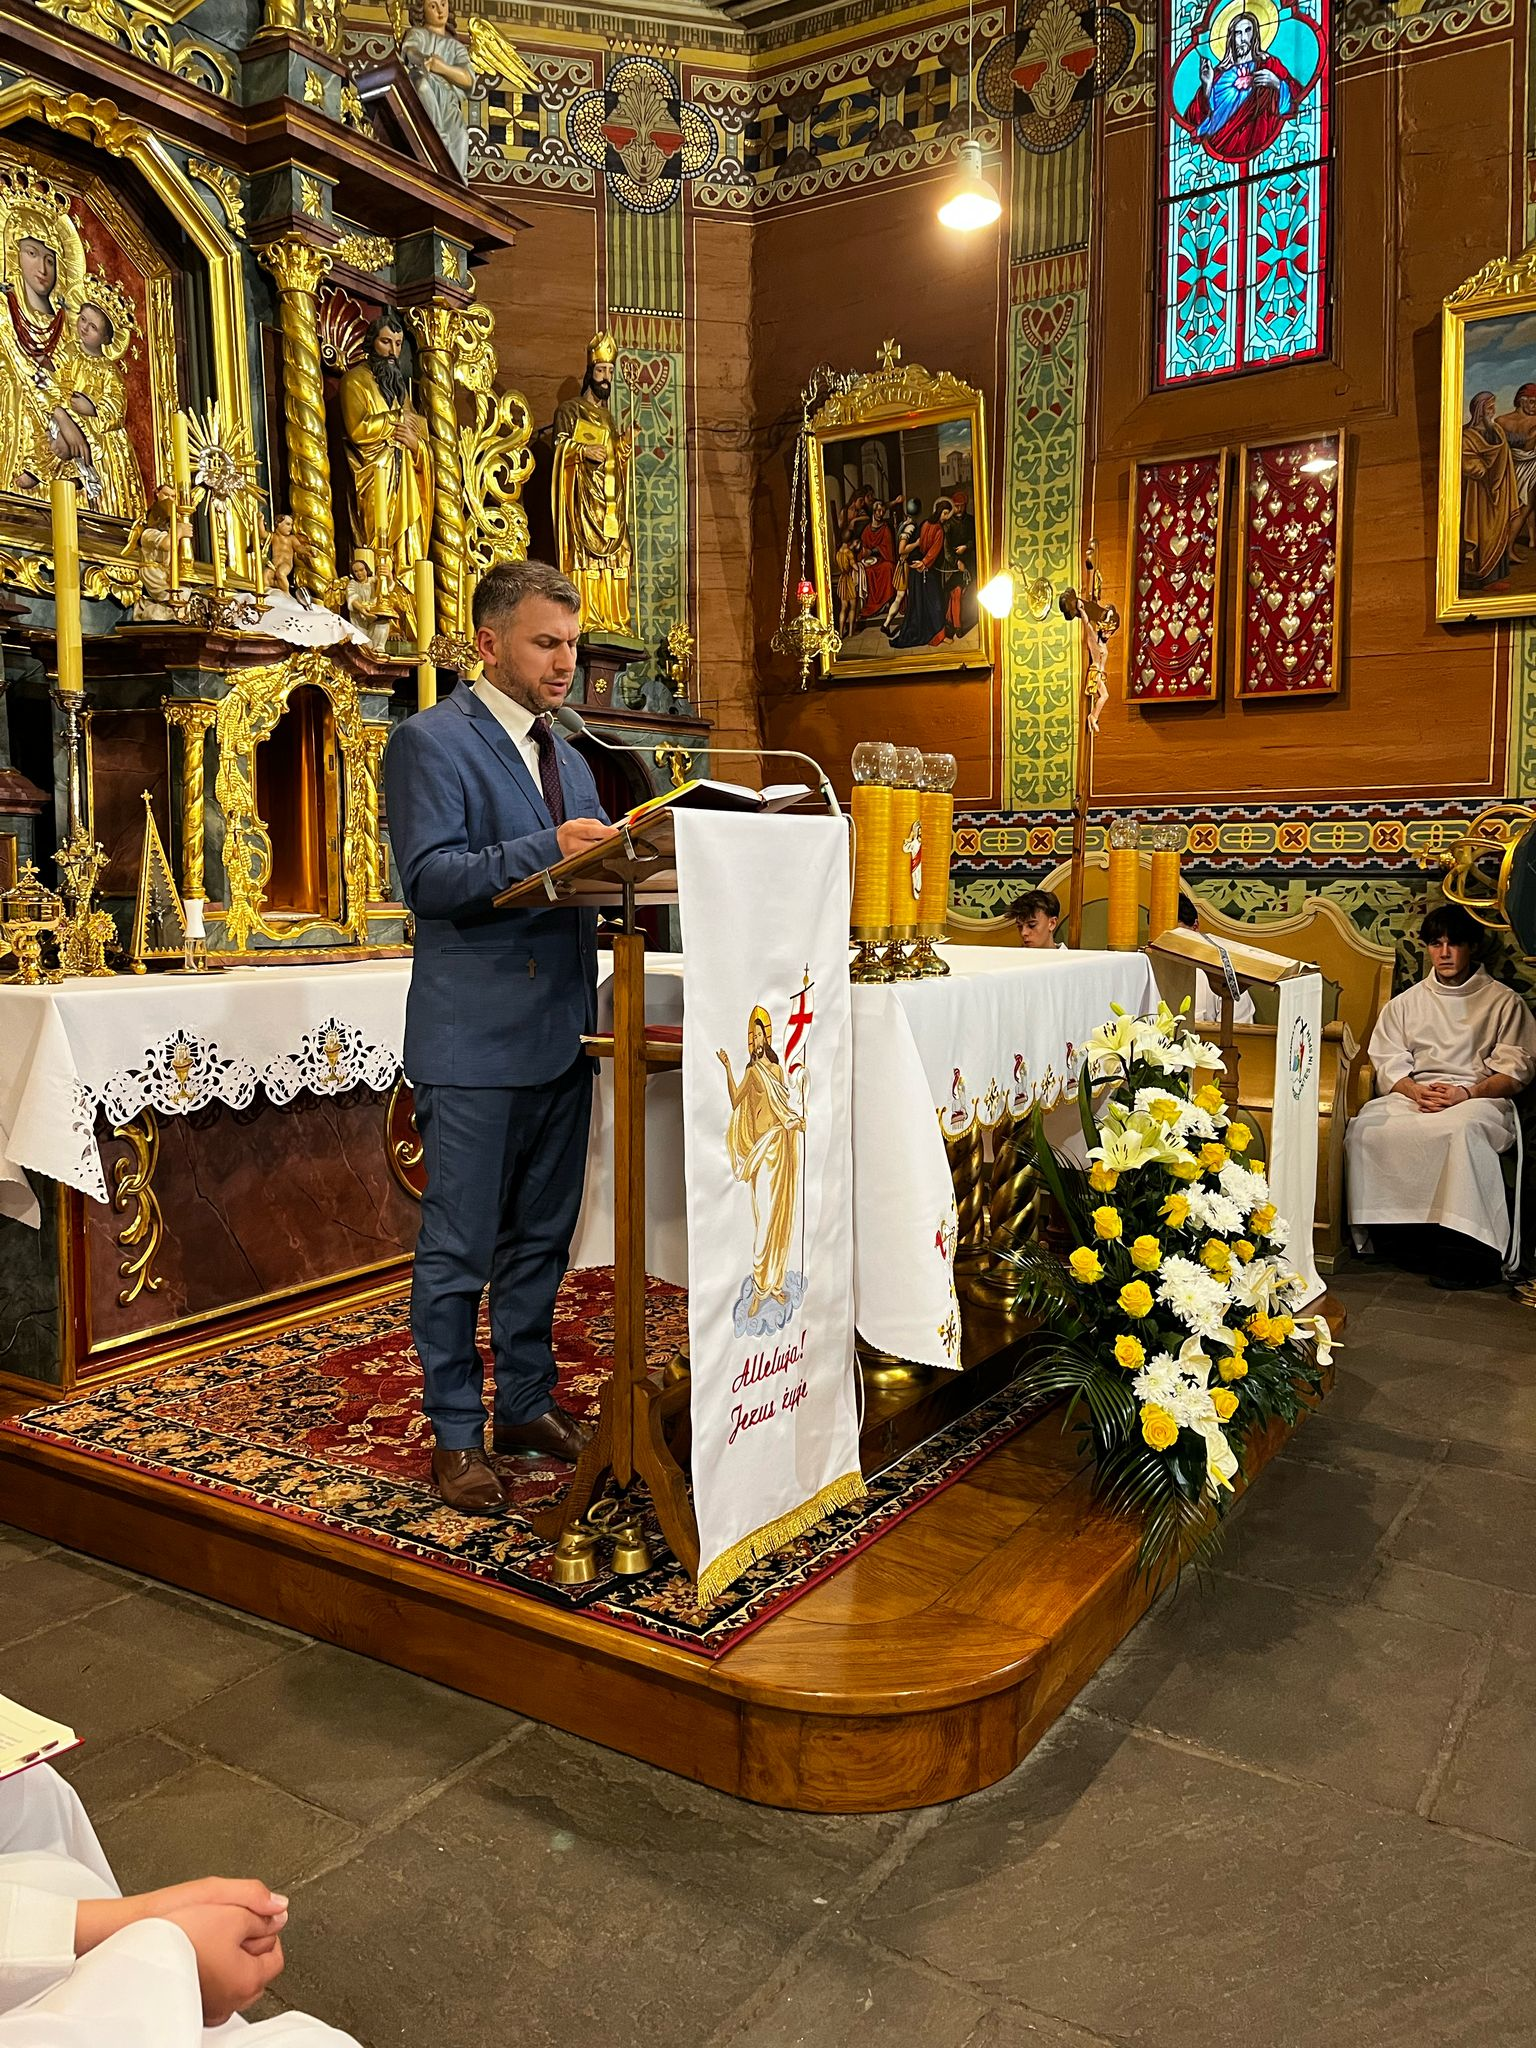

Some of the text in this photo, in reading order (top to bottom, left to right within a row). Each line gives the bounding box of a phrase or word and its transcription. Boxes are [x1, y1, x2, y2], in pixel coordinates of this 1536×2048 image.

[732, 1329, 807, 1394] Alleluja!
[728, 1379, 808, 1445] Jezus żyje
